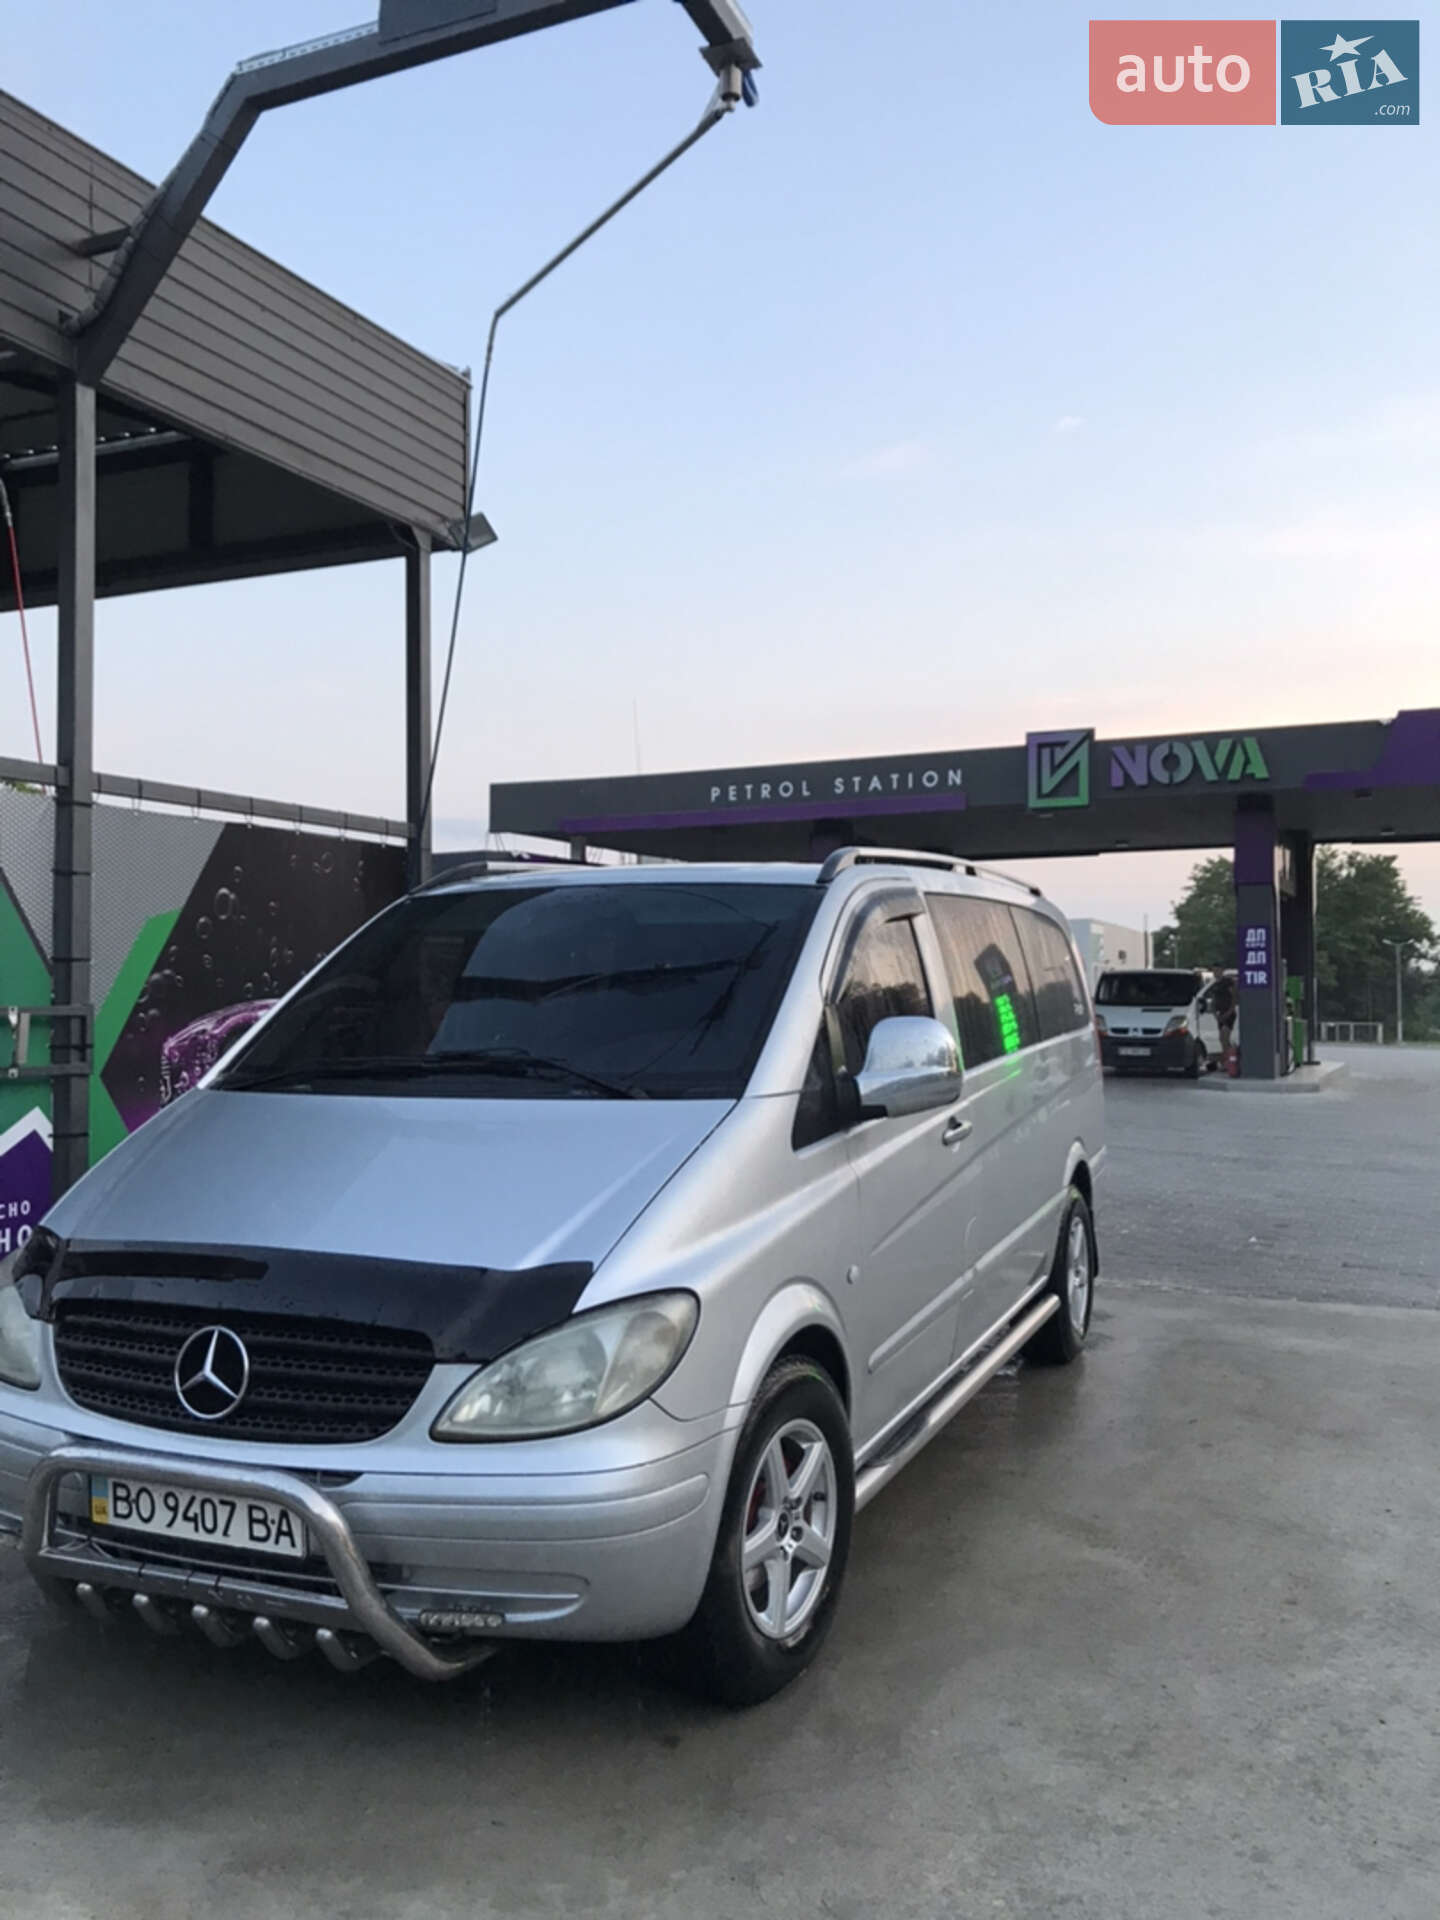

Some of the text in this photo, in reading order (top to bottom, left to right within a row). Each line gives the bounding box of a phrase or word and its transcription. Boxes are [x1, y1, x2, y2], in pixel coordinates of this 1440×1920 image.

[1110, 736, 1270, 788] NOVA
[710, 769, 962, 802] PETROL STATION
[1244, 971, 1268, 984] TIR
[111, 1480, 297, 1549] BO 9407 BA
